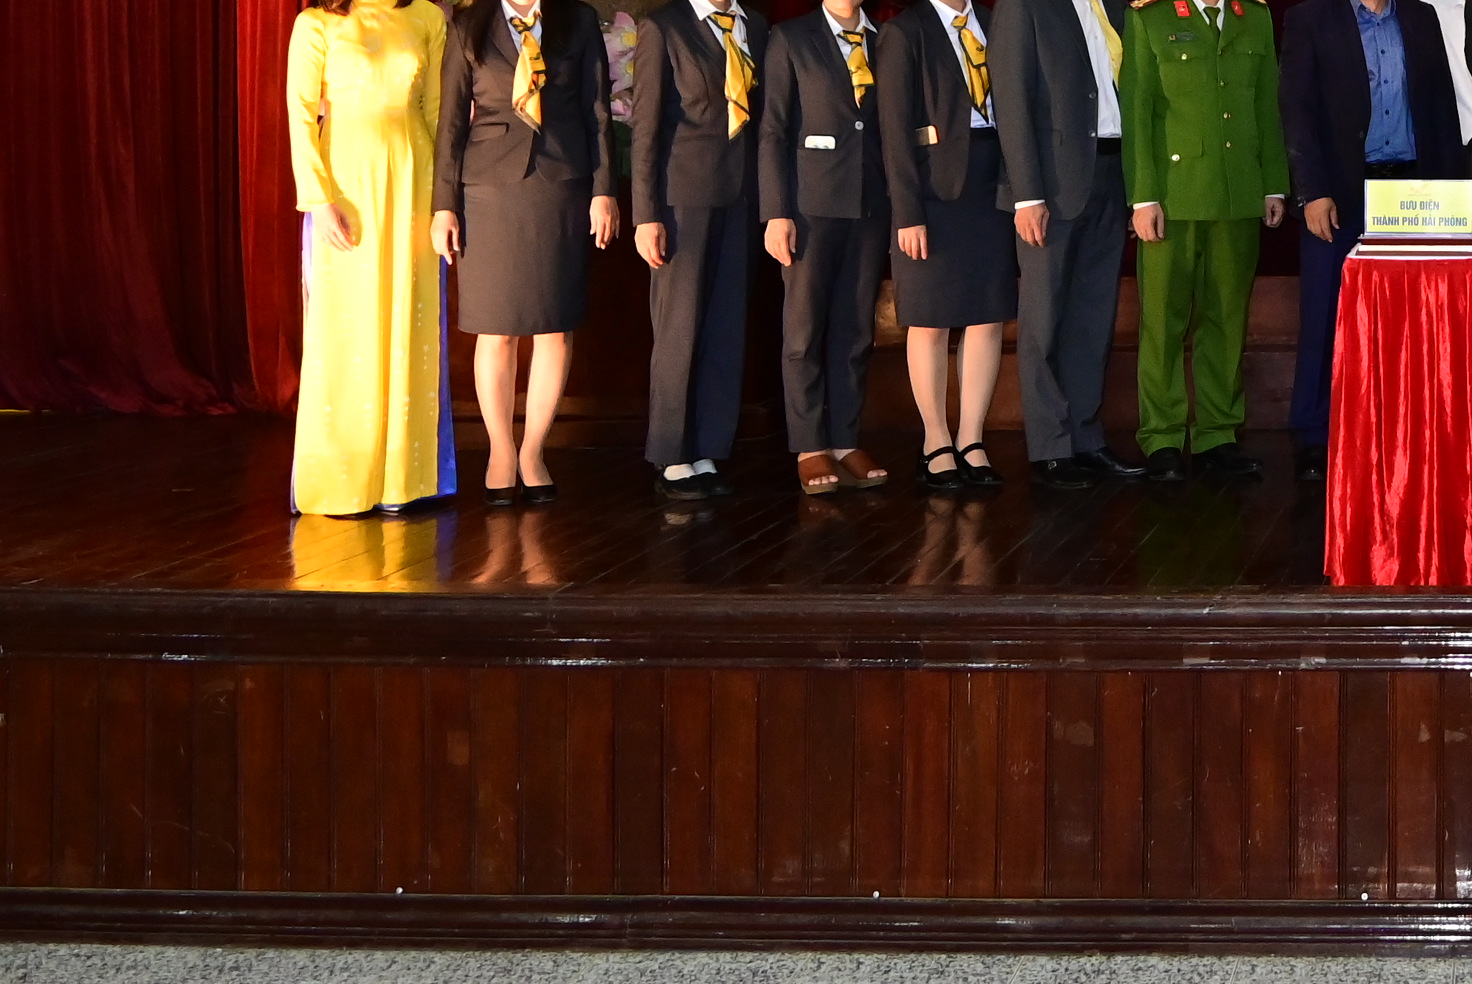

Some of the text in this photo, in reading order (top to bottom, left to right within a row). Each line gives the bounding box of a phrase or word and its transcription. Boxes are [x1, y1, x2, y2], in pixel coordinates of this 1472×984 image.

[1400, 198, 1439, 212] BƯU ĐIỆN
[1372, 213, 1467, 227] THÀNH PHỐ HẢI PHÒNG
